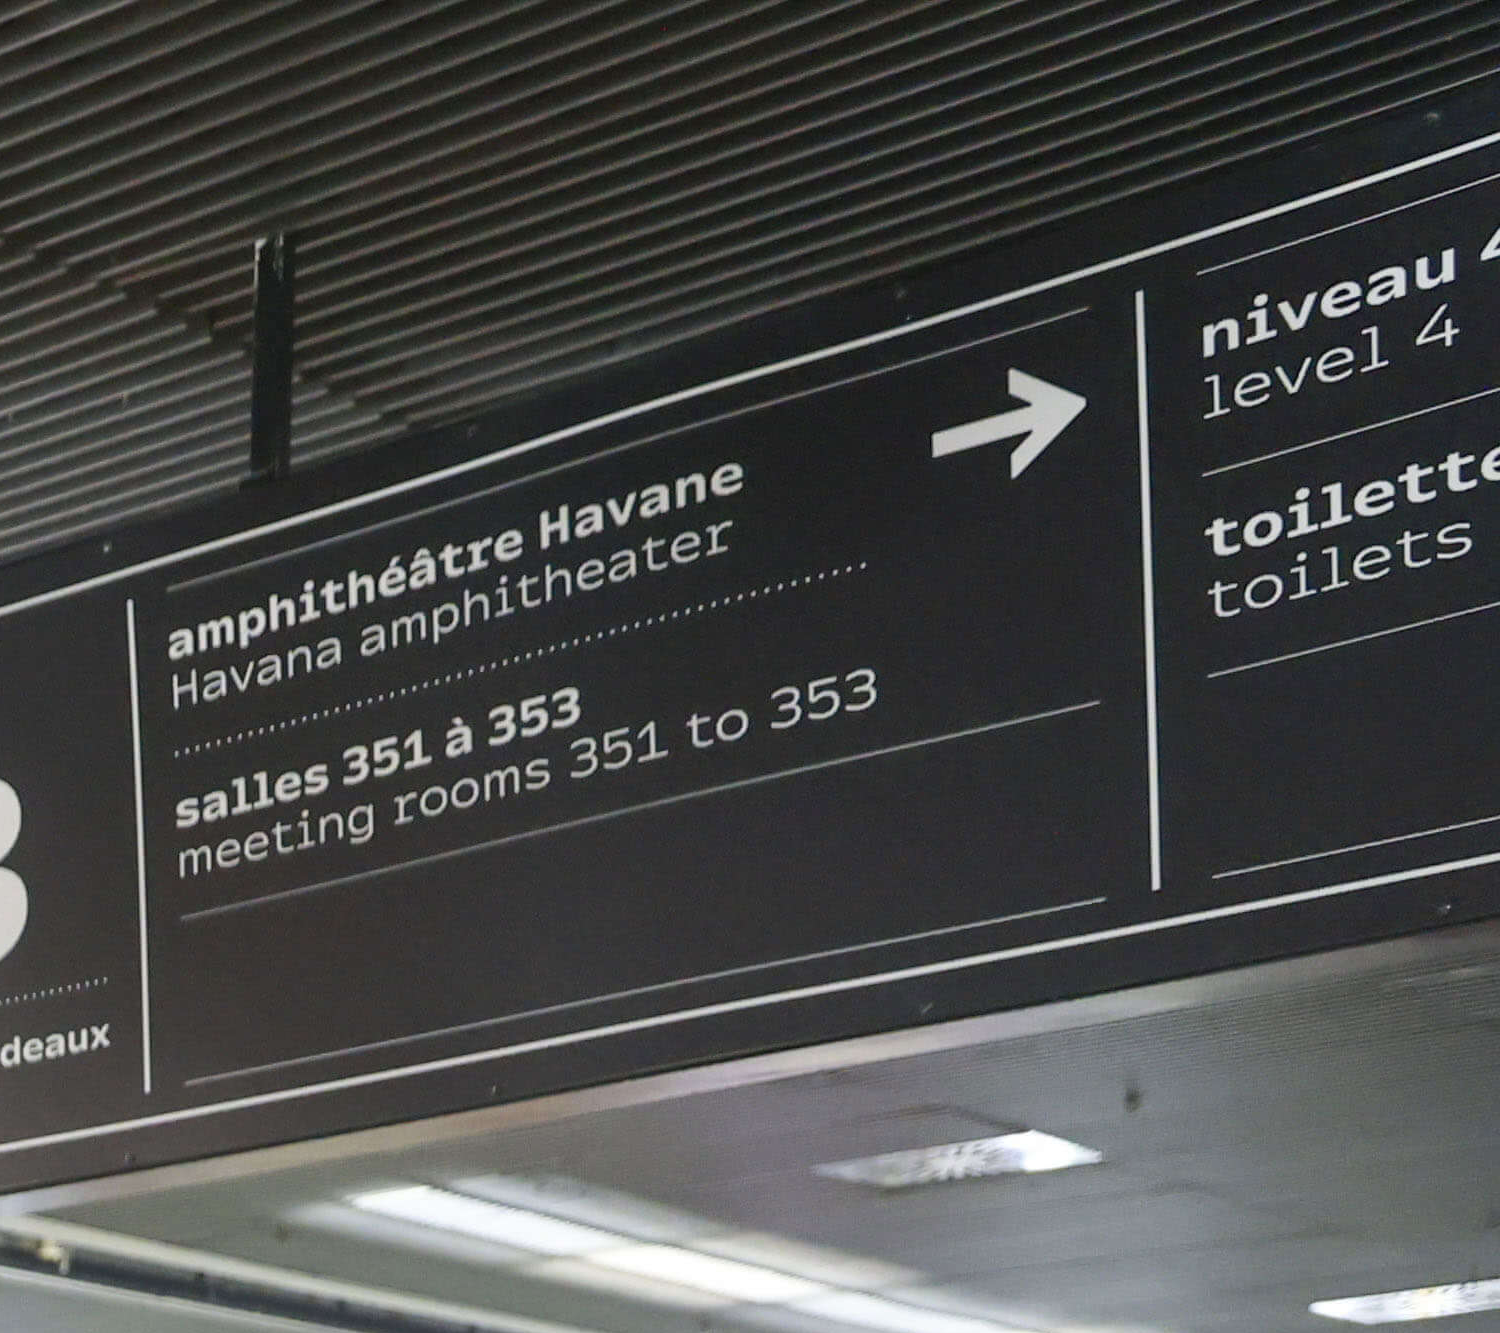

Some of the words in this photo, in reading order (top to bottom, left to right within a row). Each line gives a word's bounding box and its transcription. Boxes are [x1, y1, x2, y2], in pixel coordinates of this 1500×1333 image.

[1202, 247, 1456, 358] niveau
[1203, 325, 1390, 421] level
[1415, 303, 1461, 348] 4
[168, 528, 524, 661] amphithéâtre
[539, 461, 745, 550] Havane
[171, 635, 343, 710] Havana
[360, 518, 734, 659] amphitheater
[1207, 521, 1473, 619] toilets
[175, 760, 329, 829] salles
[342, 730, 432, 787] 351
[446, 716, 474, 760] à
[487, 687, 582, 747] 353
[178, 803, 376, 880] meeting
[394, 753, 552, 827] rooms
[569, 720, 669, 780] 351
[687, 707, 750, 751] to
[769, 667, 879, 731] 353
